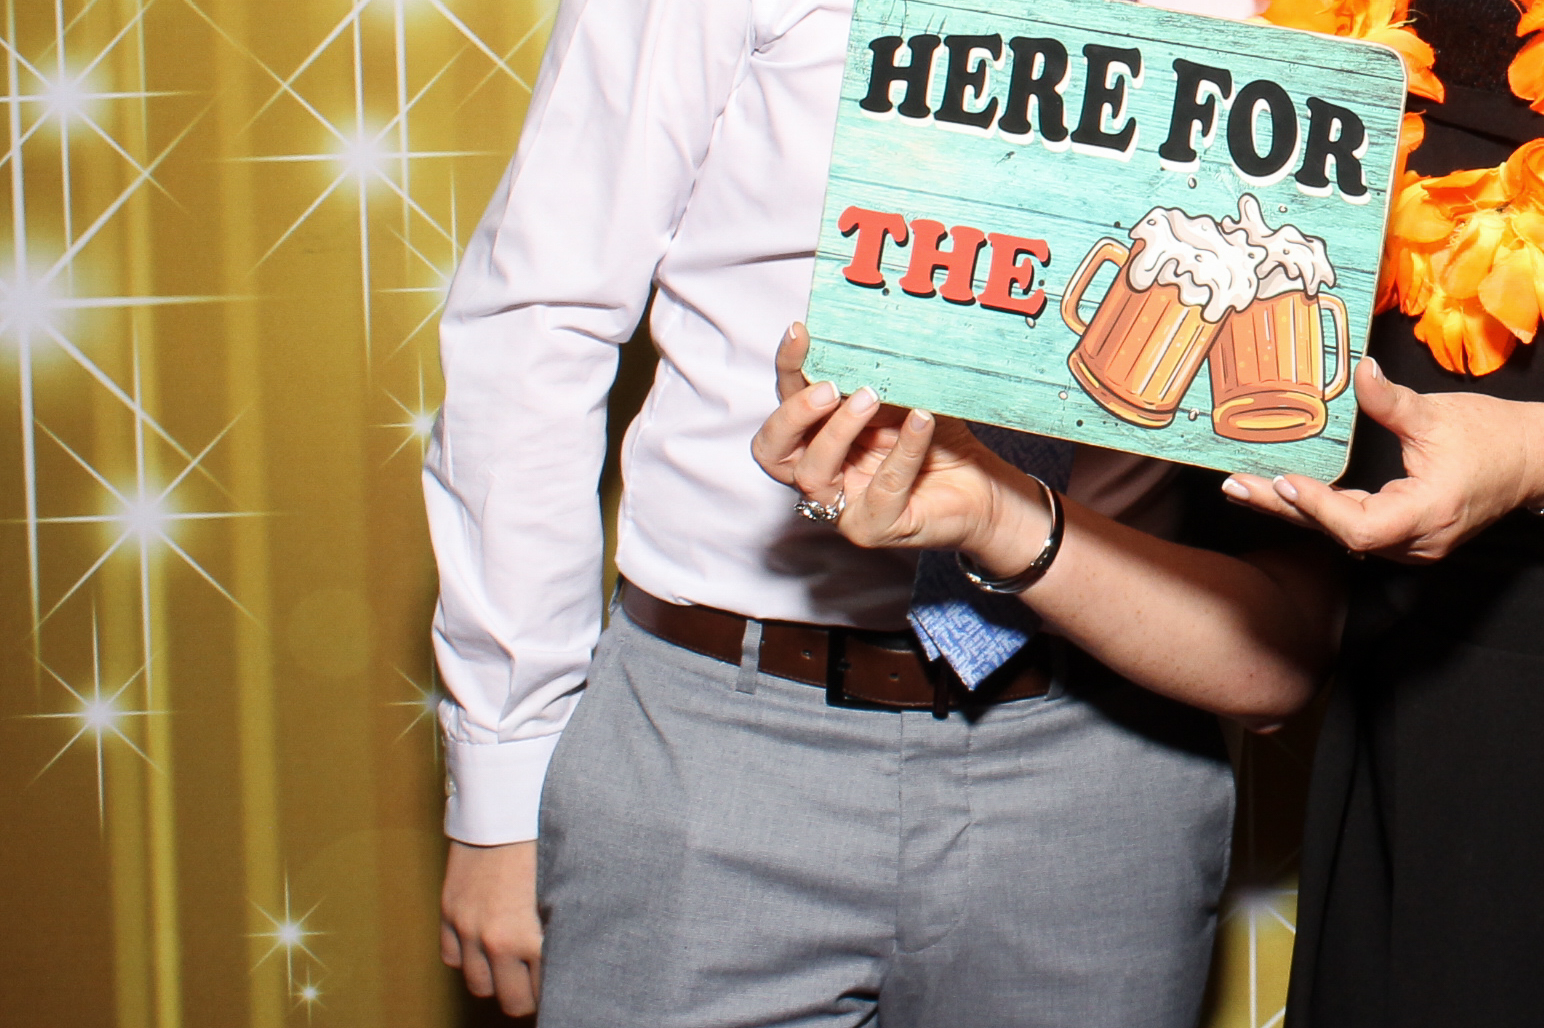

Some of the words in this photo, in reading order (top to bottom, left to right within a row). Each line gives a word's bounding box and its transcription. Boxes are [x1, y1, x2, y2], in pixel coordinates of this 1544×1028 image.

[859, 33, 1142, 156] HERE
[1158, 57, 1369, 198] FOR
[837, 205, 1051, 317] THE
